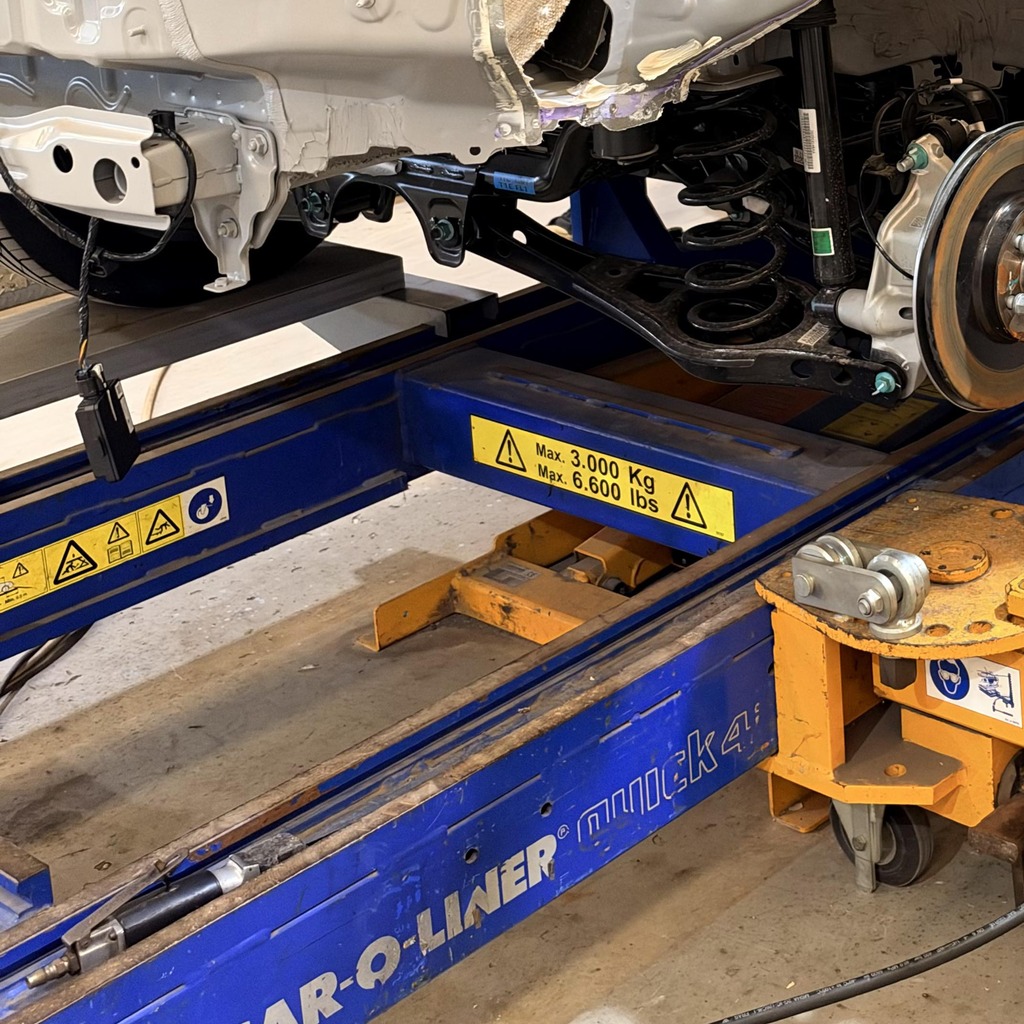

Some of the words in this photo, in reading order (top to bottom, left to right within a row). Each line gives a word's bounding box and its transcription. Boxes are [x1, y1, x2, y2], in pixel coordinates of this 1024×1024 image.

[535, 442, 566, 463] Max.
[570, 449, 620, 479] 3.000
[628, 466, 655, 495] Kg
[537, 463, 568, 485] Max.
[572, 471, 621, 501] 6.600
[630, 487, 659, 513] lbs
[241, 834, 557, 1024] R-O-LINER
